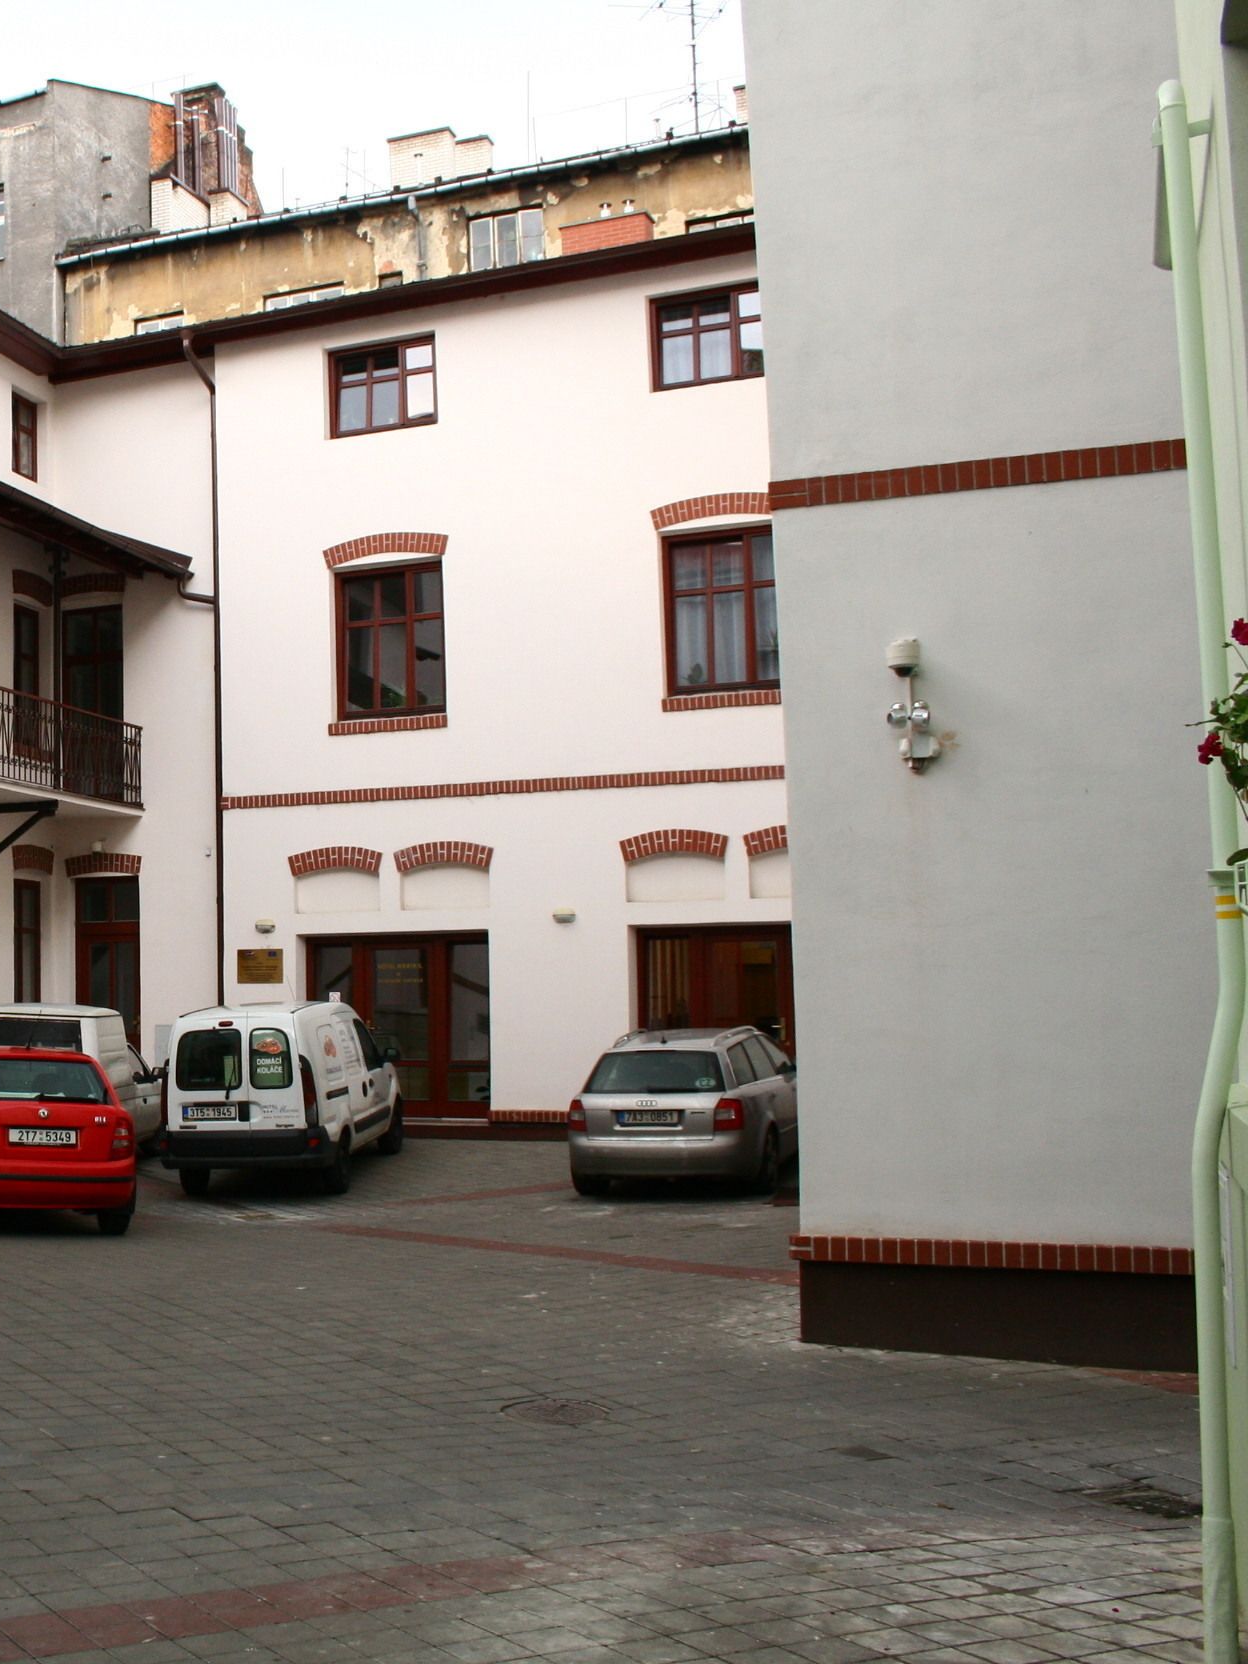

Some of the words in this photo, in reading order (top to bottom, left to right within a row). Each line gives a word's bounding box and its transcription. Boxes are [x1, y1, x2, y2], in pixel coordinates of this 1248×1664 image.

[190, 1108, 205, 1117] 3T5
[213, 1107, 232, 1116] 1945
[624, 1112, 644, 1122] 7A3
[18, 1130, 37, 1141] 2T7
[45, 1131, 71, 1142] 5349
